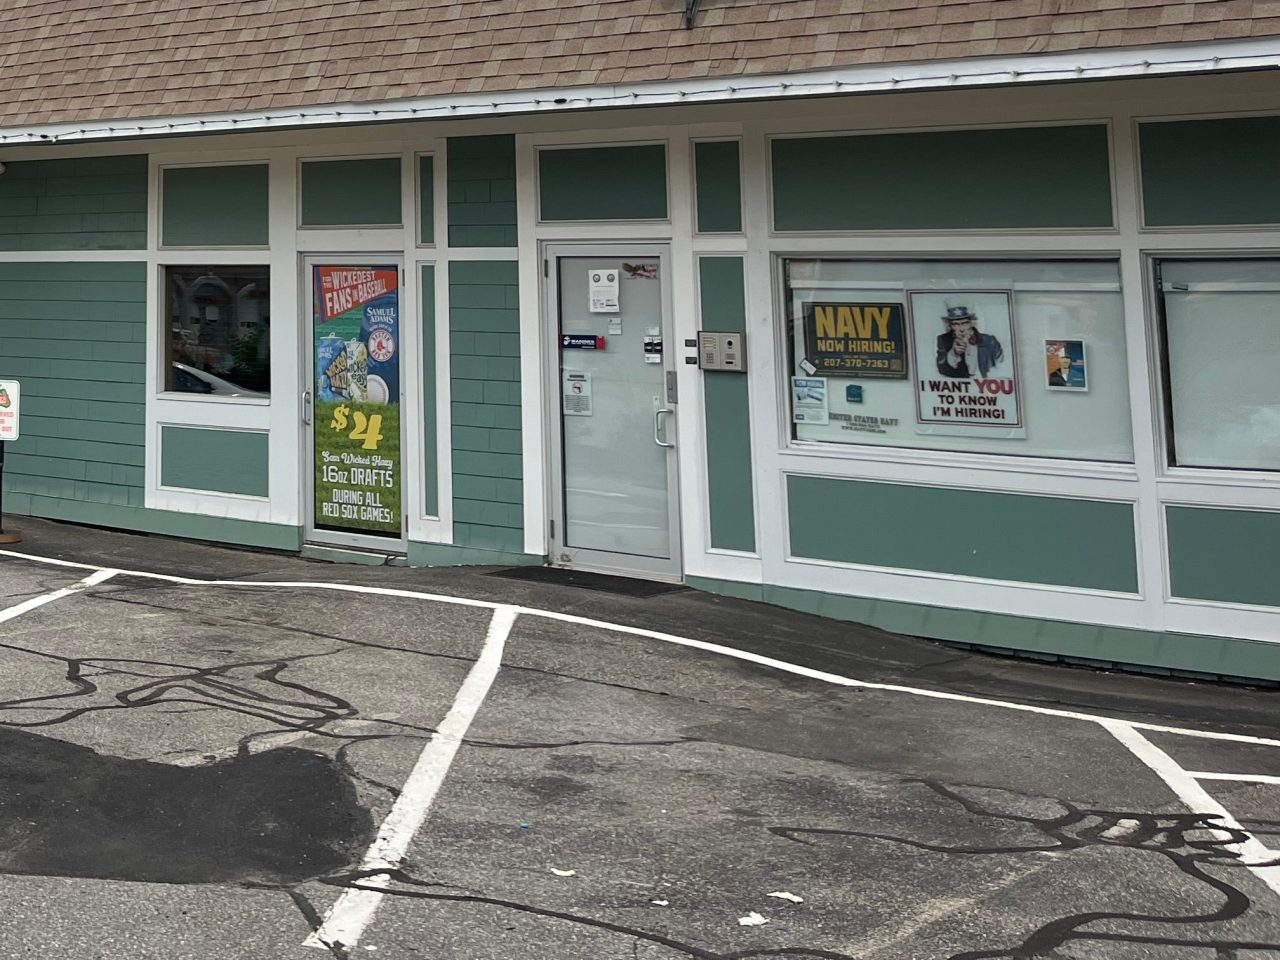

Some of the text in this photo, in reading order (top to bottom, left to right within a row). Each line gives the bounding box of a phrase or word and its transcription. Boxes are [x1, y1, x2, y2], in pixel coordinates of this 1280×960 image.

[331, 270, 376, 289] WICKEDEST
[325, 287, 353, 317] FANS
[357, 278, 387, 303] BASEBALL
[366, 306, 396, 317] SAMUEL
[370, 316, 394, 324] ADAMS
[814, 306, 891, 339] NAVY
[817, 339, 895, 353] NOW HIRING!
[920, 379, 1014, 395] I WANT YOU
[937, 394, 998, 406] TO KNOW
[933, 406, 1006, 419] I'M HIRING!
[330, 403, 383, 450] $4
[321, 450, 340, 462] Sam
[341, 452, 370, 465] Wicked
[350, 467, 393, 488] DRAFTS
[332, 488, 383, 507] DURING ALL
[322, 502, 394, 523] RED SOX GAMES!
